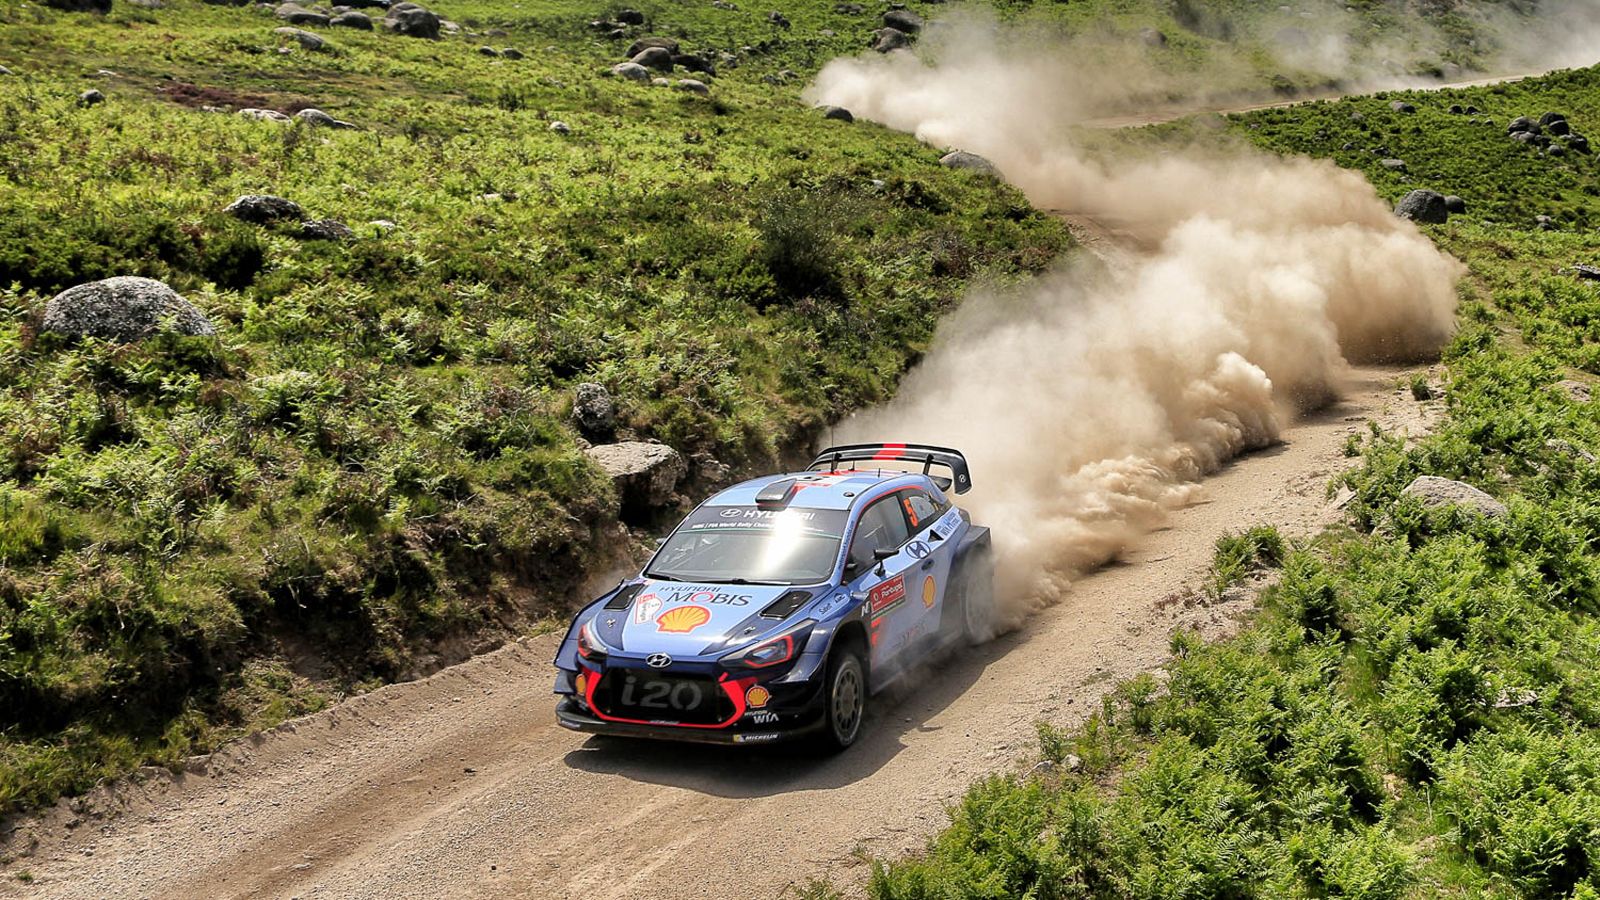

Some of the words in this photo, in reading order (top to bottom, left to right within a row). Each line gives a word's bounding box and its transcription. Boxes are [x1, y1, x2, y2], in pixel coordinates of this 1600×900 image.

[903, 497, 918, 528] 5
[660, 585, 722, 593] HYUNDAI
[881, 581, 904, 599] Portugal
[666, 591, 753, 607] MOBIS
[620, 675, 701, 711] i20
[743, 709, 768, 717] HYUNDAI
[745, 733, 779, 741] MICHELIN
